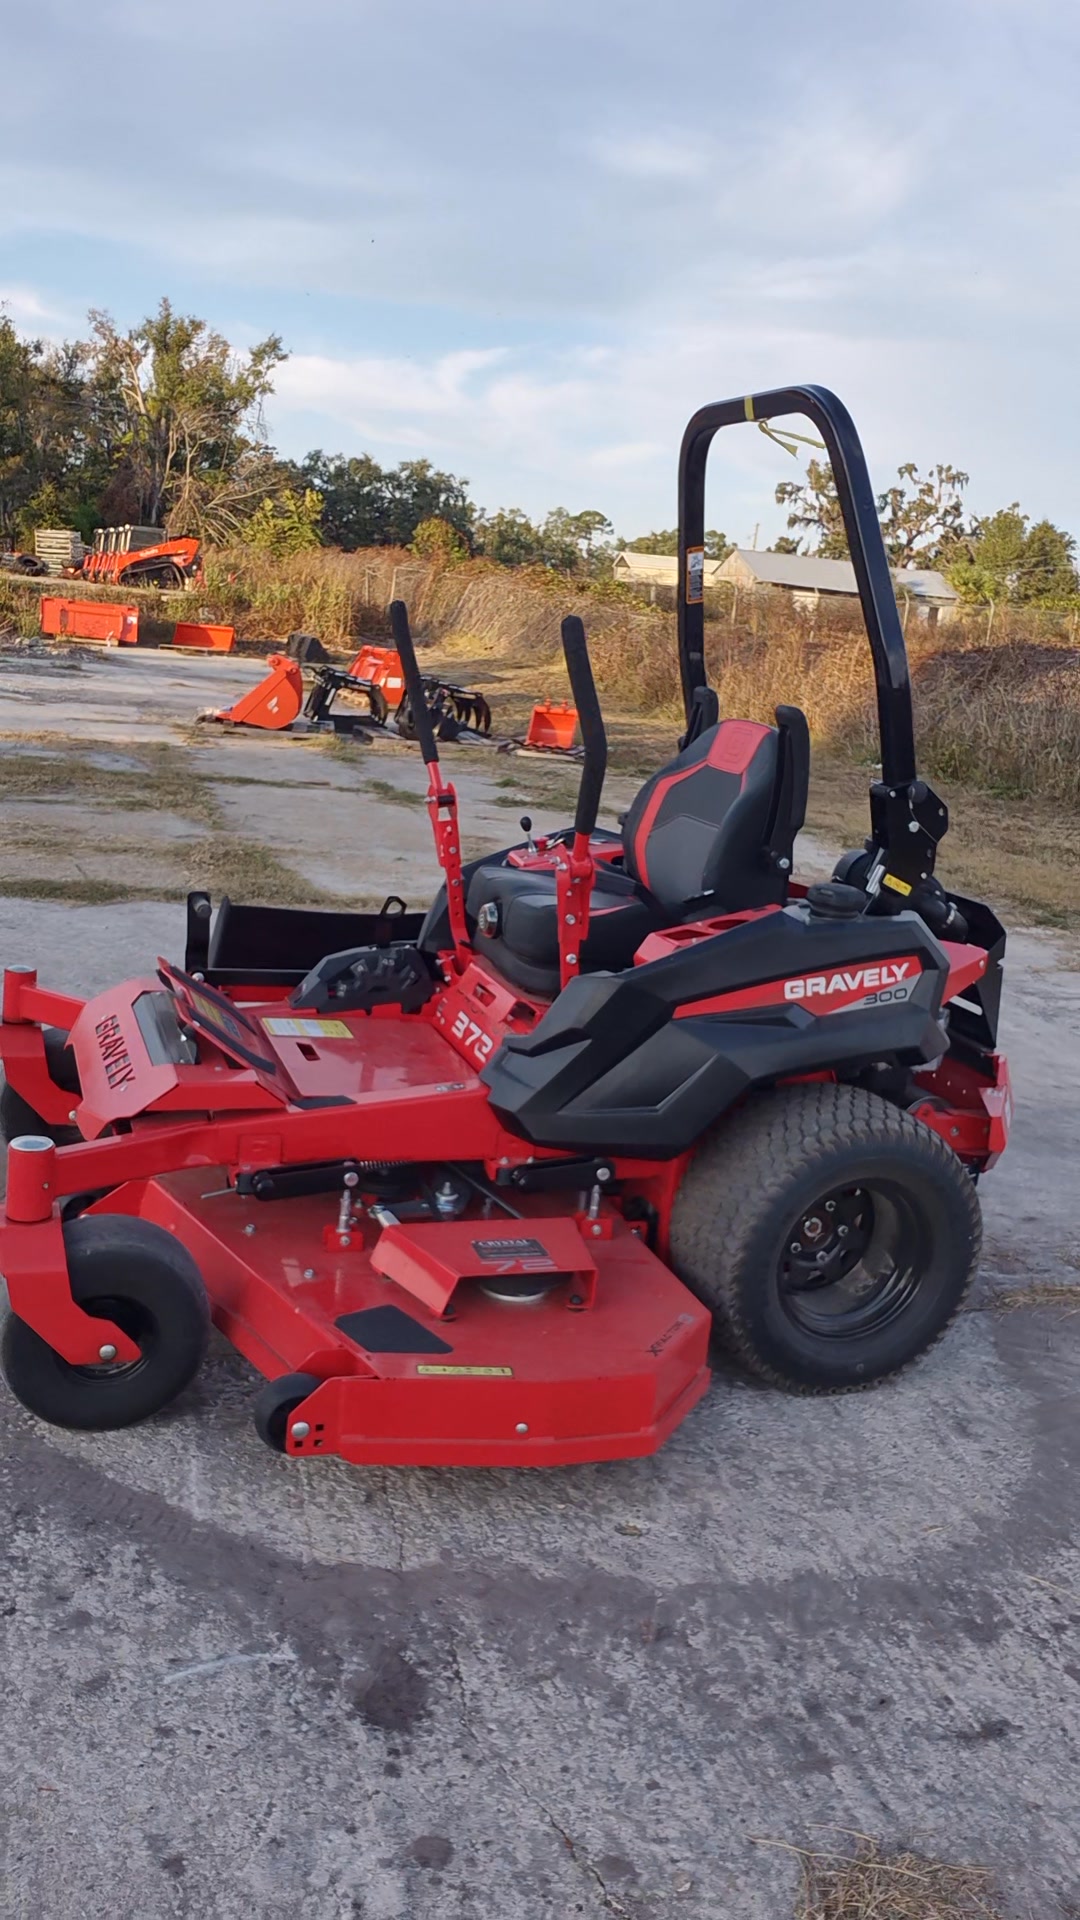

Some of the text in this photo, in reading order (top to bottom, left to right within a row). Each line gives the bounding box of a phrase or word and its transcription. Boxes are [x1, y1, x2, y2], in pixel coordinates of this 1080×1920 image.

[784, 962, 909, 1000] GRAVELY
[863, 988, 908, 1006] 300
[95, 1014, 136, 1090] GRAVELY
[451, 1010, 494, 1064] 372
[480, 1259, 558, 1273] 72
